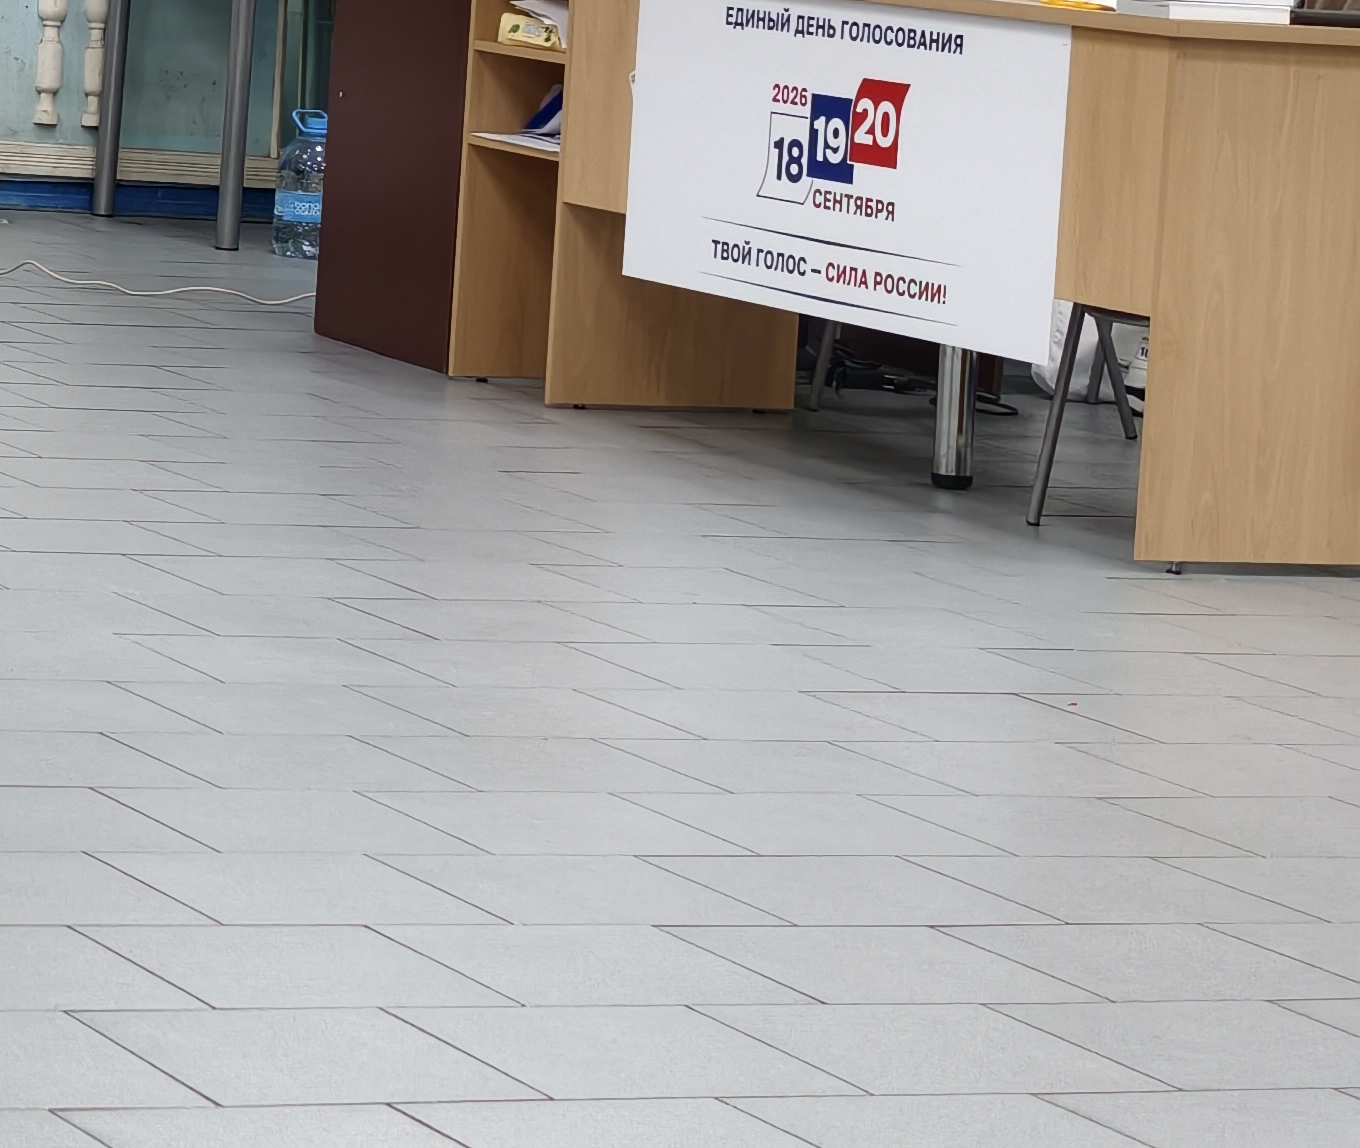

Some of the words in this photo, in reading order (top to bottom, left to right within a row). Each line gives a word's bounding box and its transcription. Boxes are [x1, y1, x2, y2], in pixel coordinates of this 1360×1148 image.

[724, 6, 792, 33] ЕДИНЫЙ
[794, 13, 837, 39] ДЕНЬ
[839, 20, 965, 55] ГОЛОСОВАНИЯ
[771, 83, 809, 107] 2026
[813, 116, 847, 165] 19
[854, 98, 897, 148] 20
[773, 137, 805, 184] 18
[811, 188, 897, 222] СЕНТЯБРЯ
[711, 238, 753, 267] ТВОЙ
[755, 247, 808, 278] ГОЛОС
[824, 260, 870, 291] СИЛА
[872, 271, 948, 305] РОССИИ!
